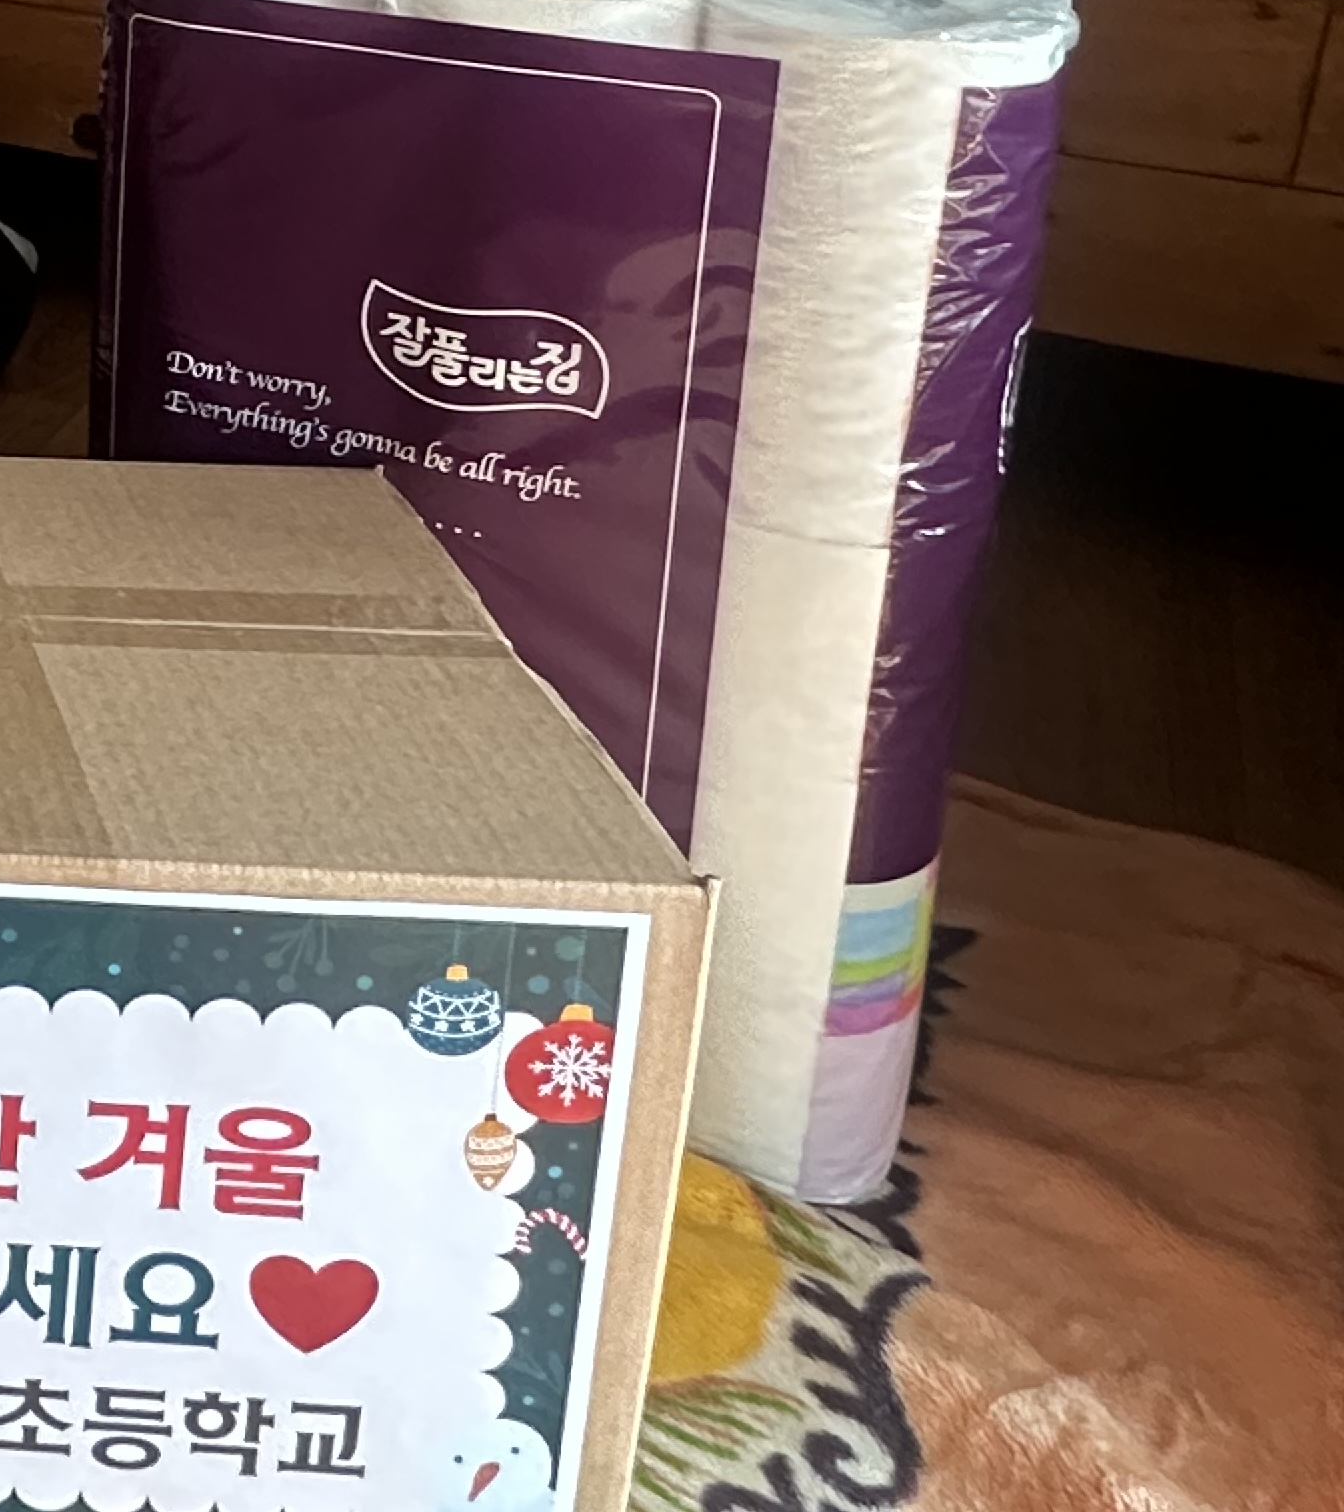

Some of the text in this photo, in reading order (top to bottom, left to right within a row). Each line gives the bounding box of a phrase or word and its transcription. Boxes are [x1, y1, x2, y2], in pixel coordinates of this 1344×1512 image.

[166, 350, 332, 410] Don't worry,
[379, 312, 582, 396] 잘풀리는집
[163, 390, 582, 501] Everything's gonna be all right.
[76, 1098, 320, 1220] 겨울
